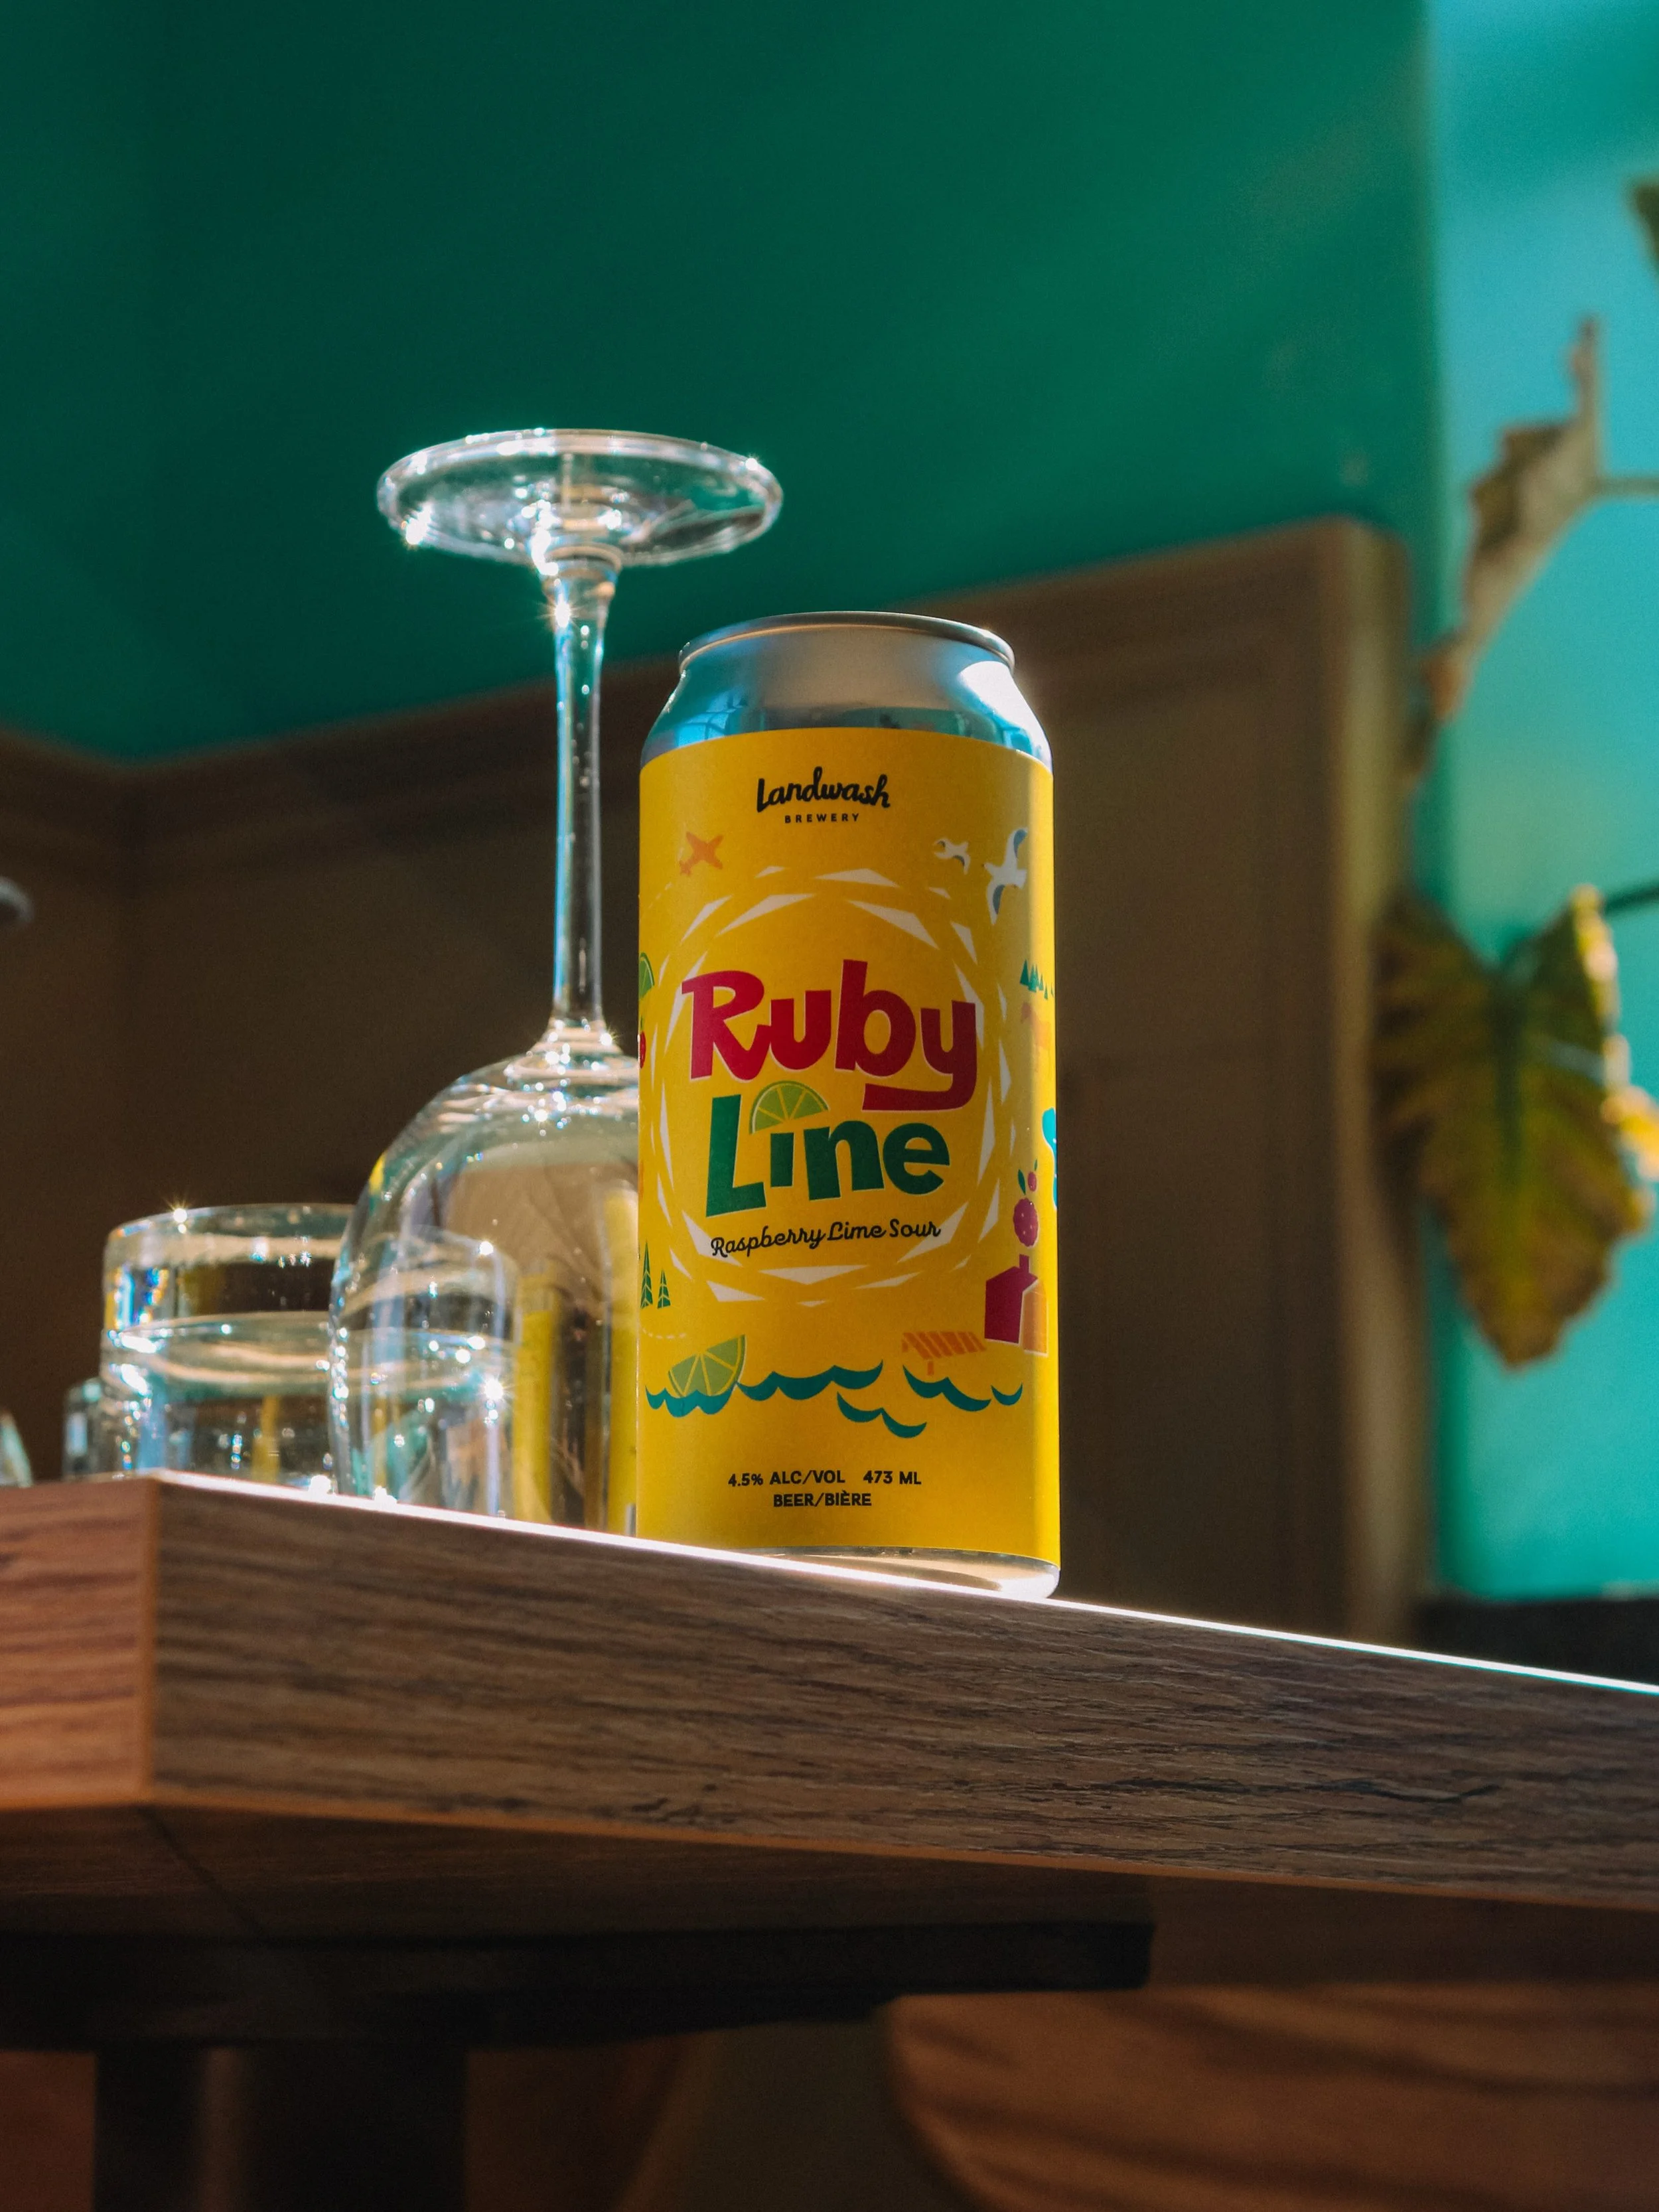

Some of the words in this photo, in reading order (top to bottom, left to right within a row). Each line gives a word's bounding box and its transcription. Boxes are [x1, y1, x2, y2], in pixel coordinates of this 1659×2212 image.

[757, 766, 891, 813] Landwash
[784, 812, 860, 824] BREWERY
[681, 959, 977, 1112] Ruby
[705, 1094, 951, 1217] Line
[710, 1224, 826, 1258] Raspberry
[827, 1219, 887, 1242] Lime
[889, 1218, 941, 1238] Sour
[727, 1473, 764, 1487] 4.5%
[768, 1470, 845, 1485] ALC/VOL
[863, 1470, 893, 1485] 473
[899, 1471, 922, 1485] ML
[773, 1490, 873, 1507] BEER/BIÈRE
